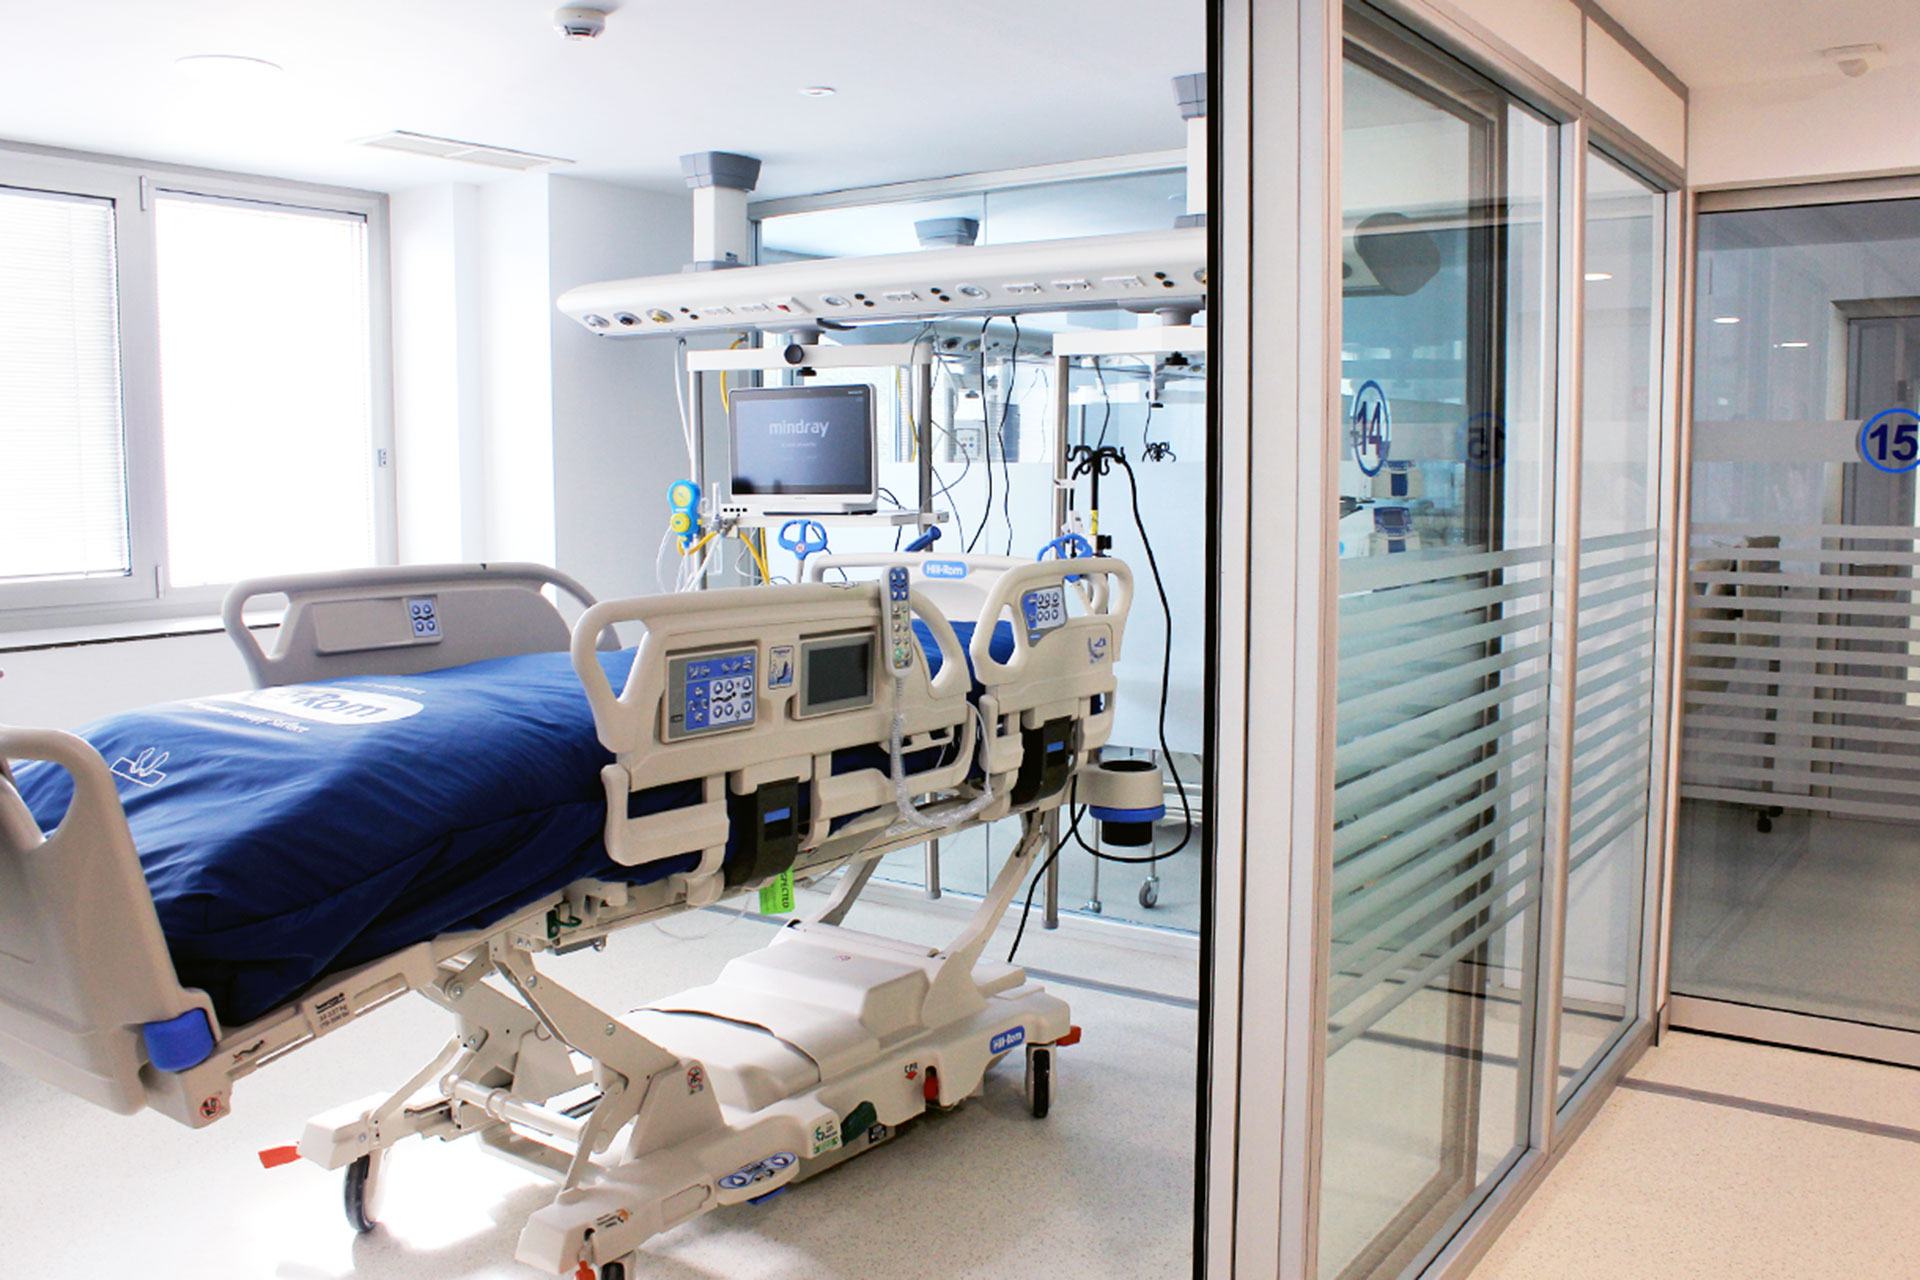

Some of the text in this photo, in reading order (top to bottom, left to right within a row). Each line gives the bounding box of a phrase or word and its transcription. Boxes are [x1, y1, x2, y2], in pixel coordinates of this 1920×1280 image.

[769, 420, 829, 438] mindray
[1357, 401, 1382, 456] 14
[1869, 424, 1919, 461] 15
[926, 564, 963, 576] Hill-Rom
